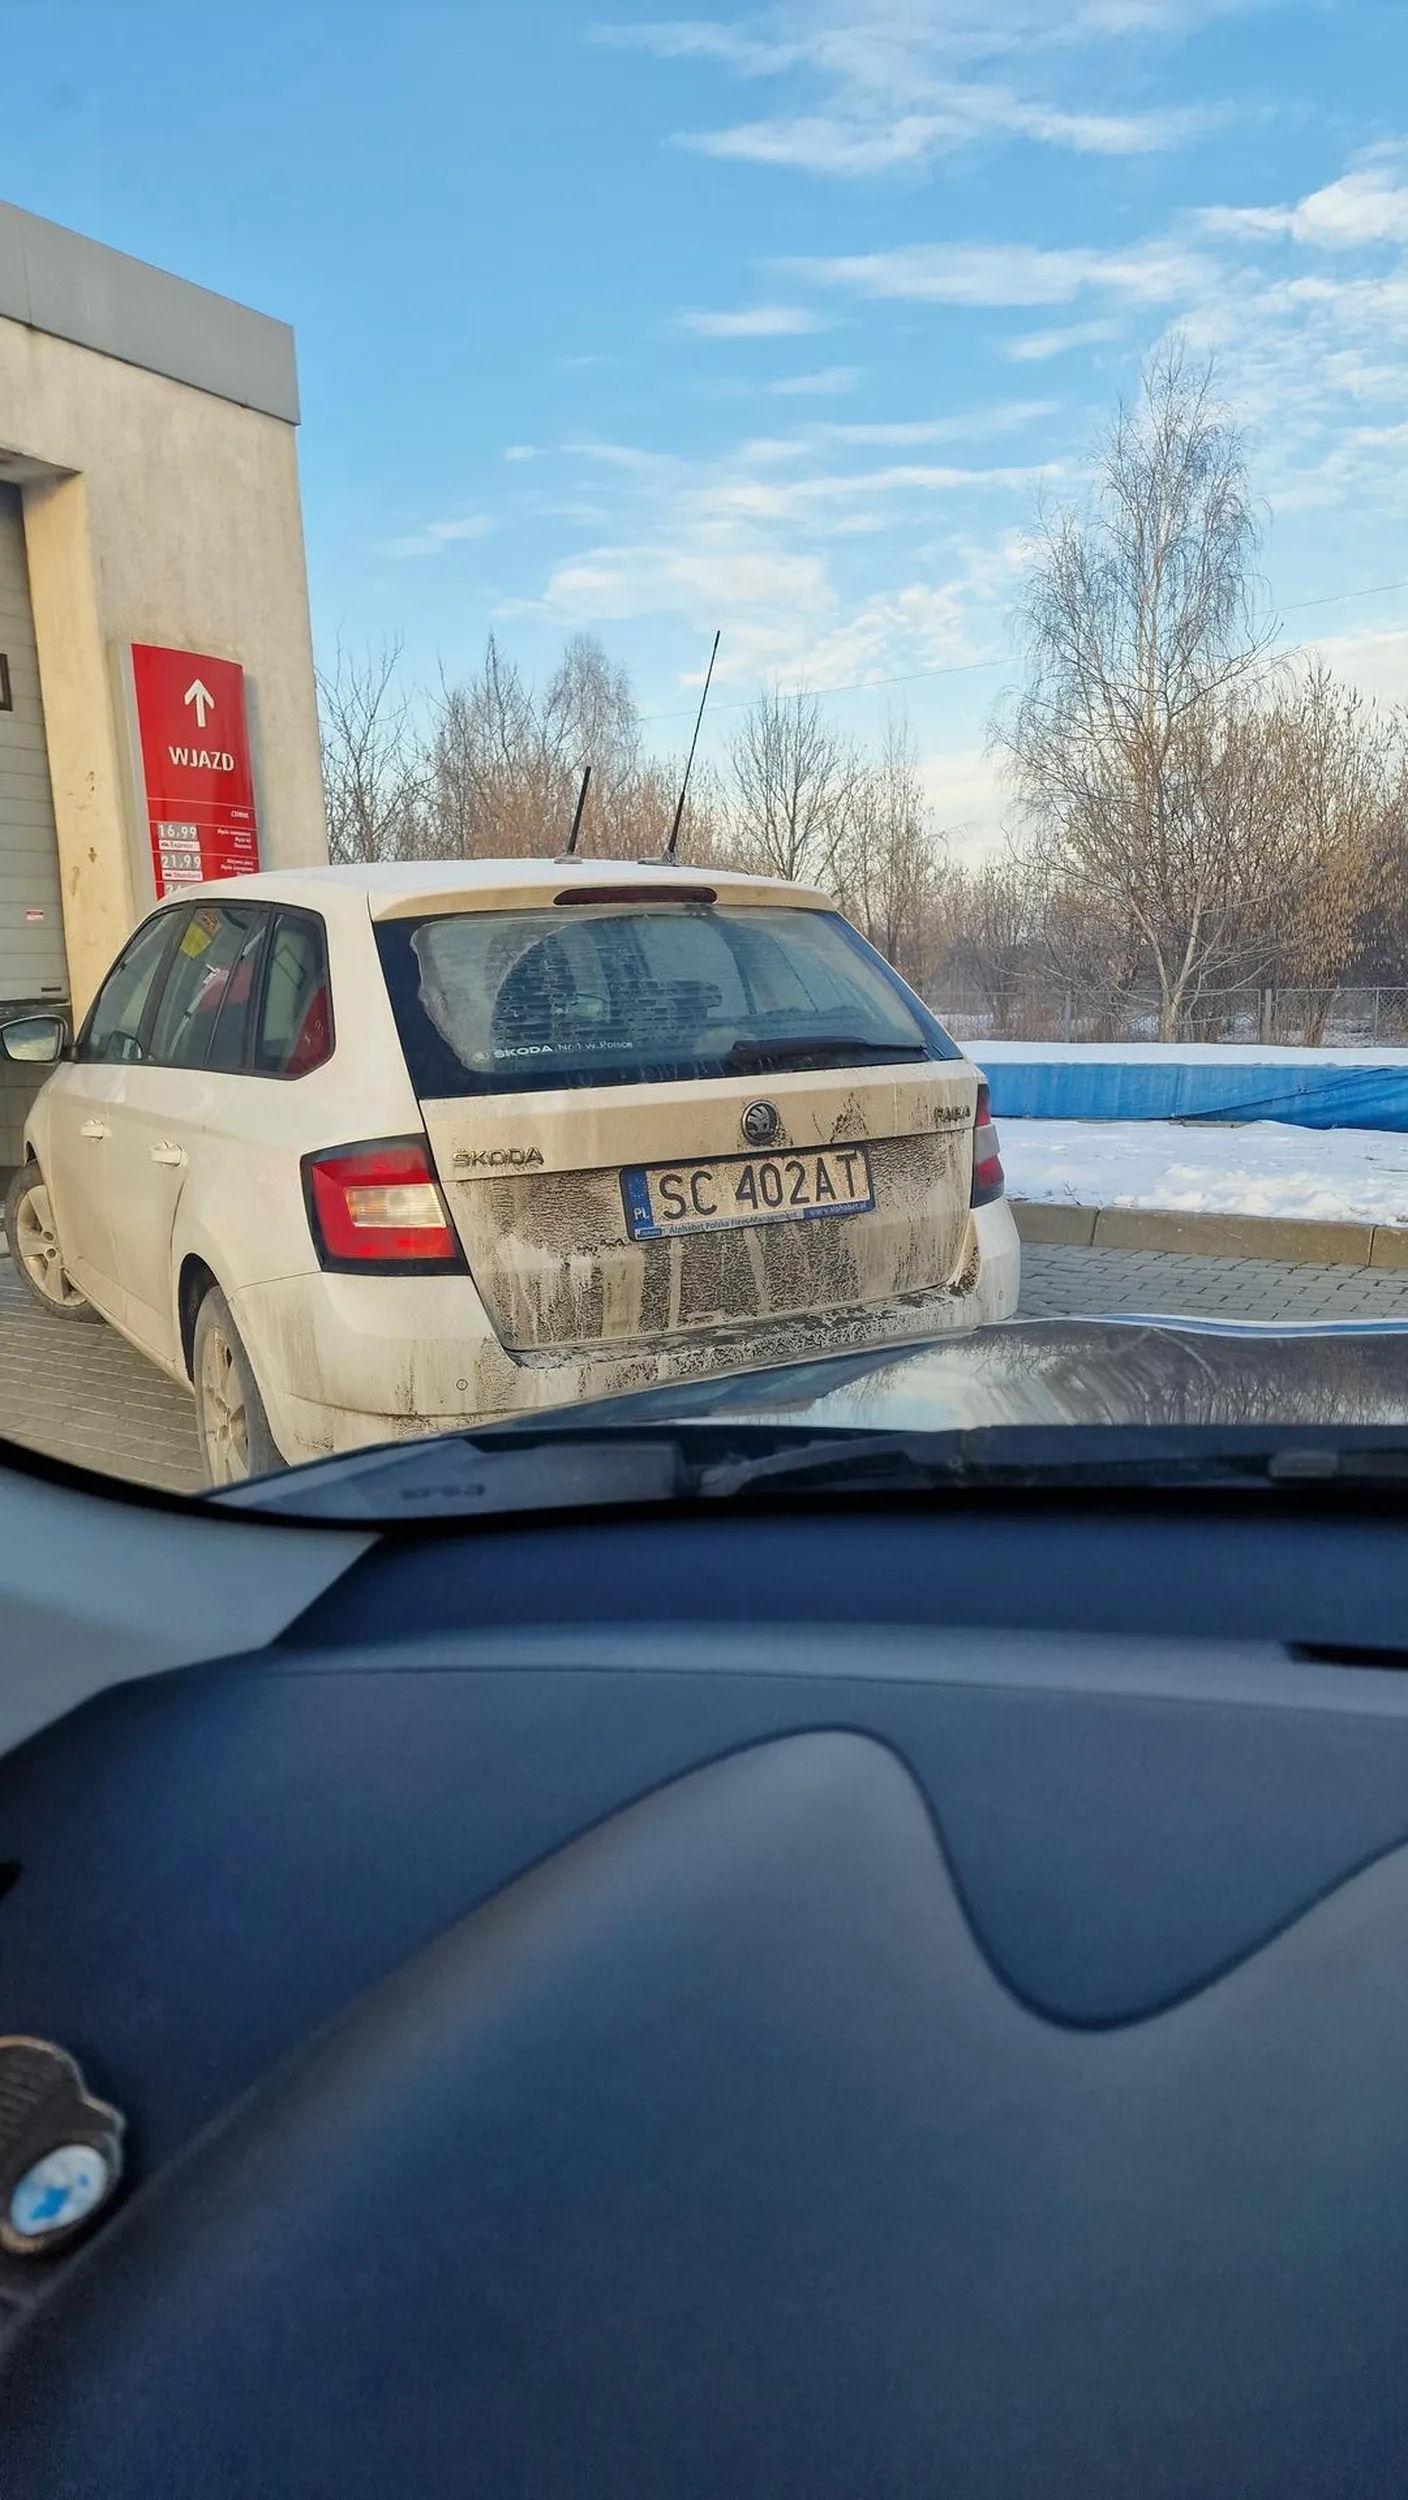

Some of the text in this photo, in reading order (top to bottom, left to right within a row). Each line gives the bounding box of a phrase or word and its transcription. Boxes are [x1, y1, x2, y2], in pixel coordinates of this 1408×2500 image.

[168, 745, 235, 772] WJAZD
[659, 1150, 857, 1219] SC 402AT
[633, 1207, 649, 1220] PL
[705, 1219, 730, 1230] Polska
